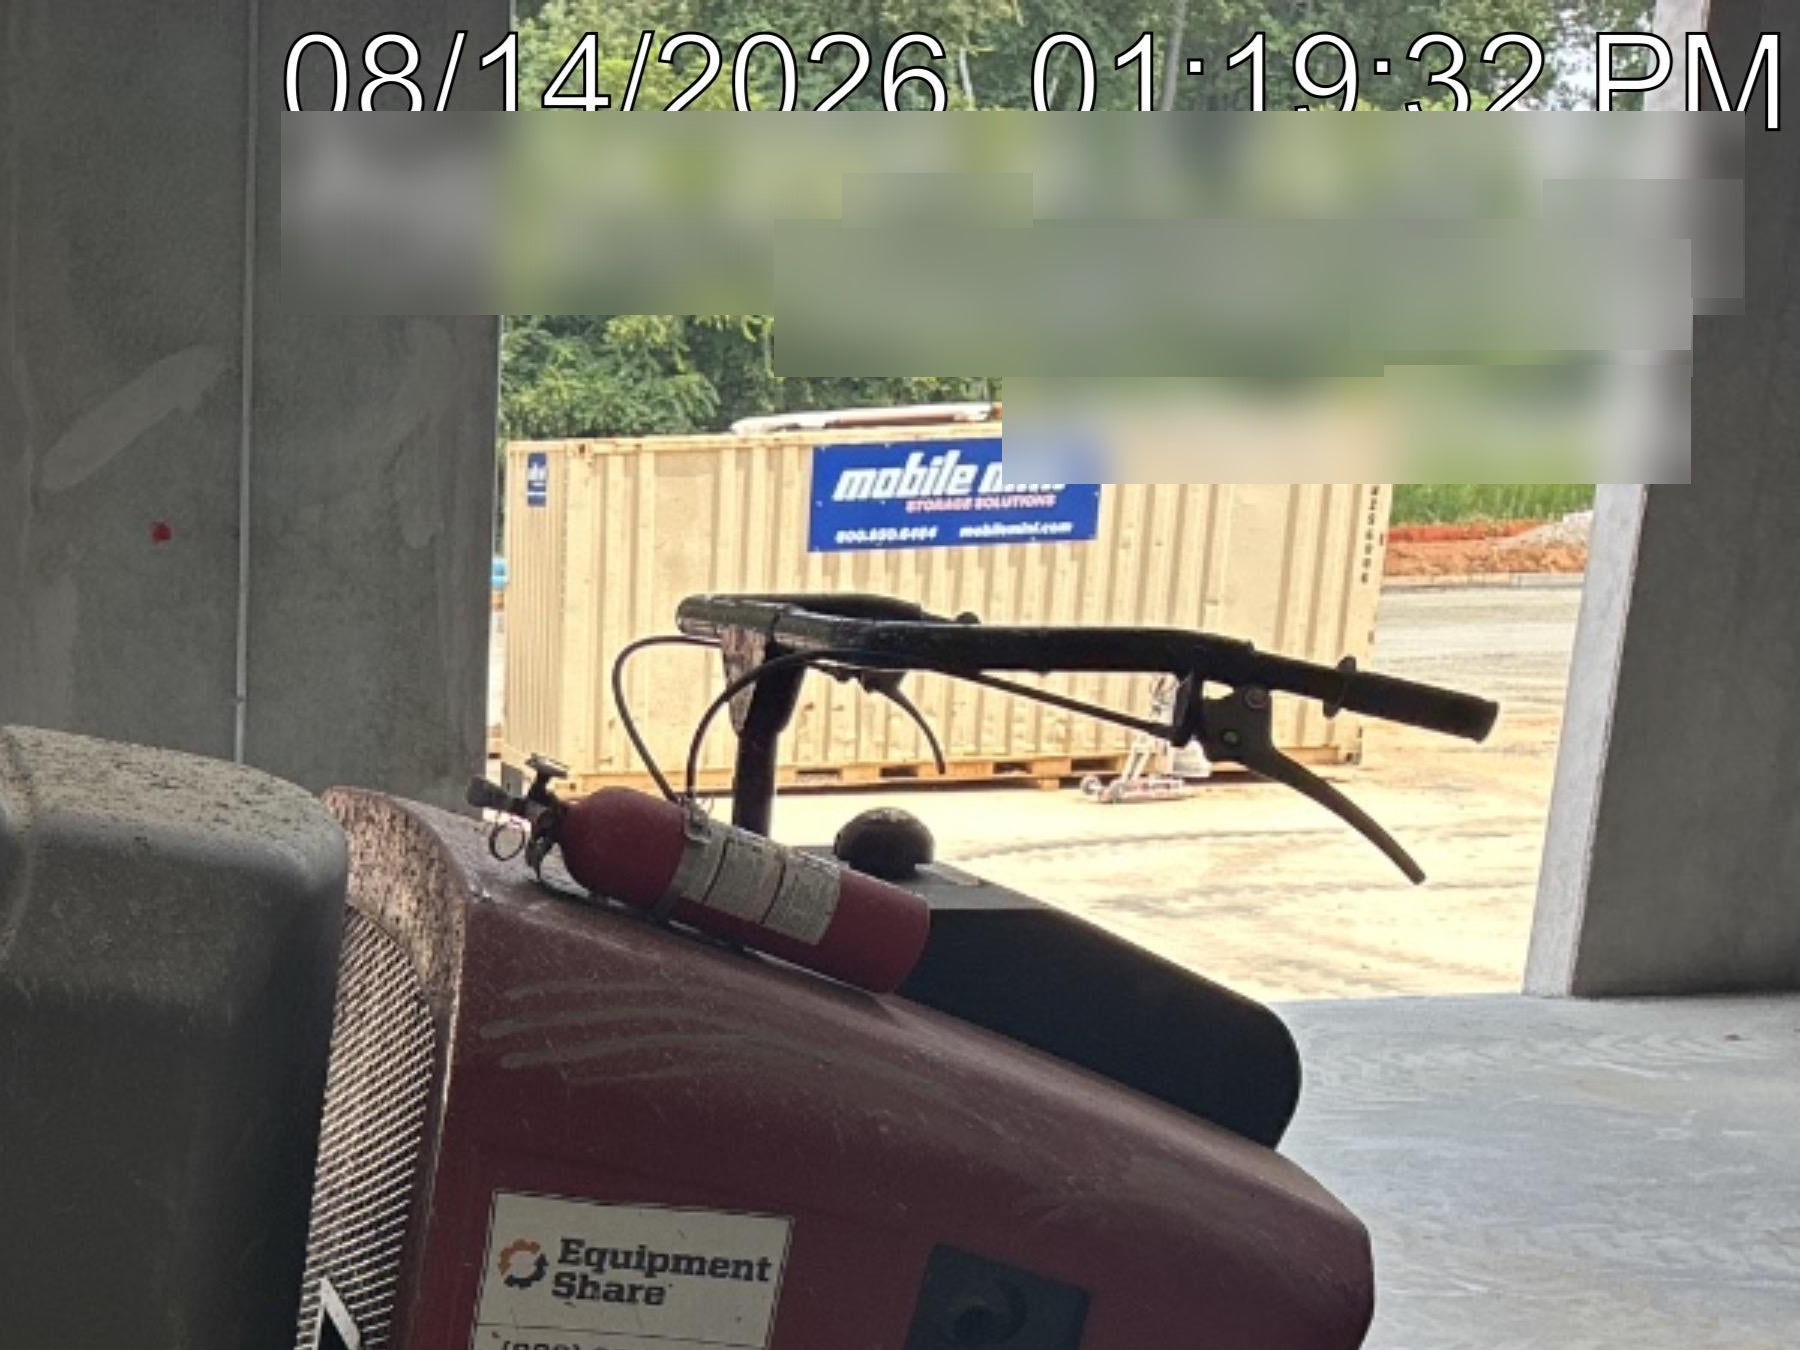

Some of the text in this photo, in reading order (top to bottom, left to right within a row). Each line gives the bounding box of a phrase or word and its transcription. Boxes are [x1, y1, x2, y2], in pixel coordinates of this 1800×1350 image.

[833, 448, 978, 501] mobile
[557, 1237, 772, 1283] Equipment
[552, 1271, 667, 1306] Share
